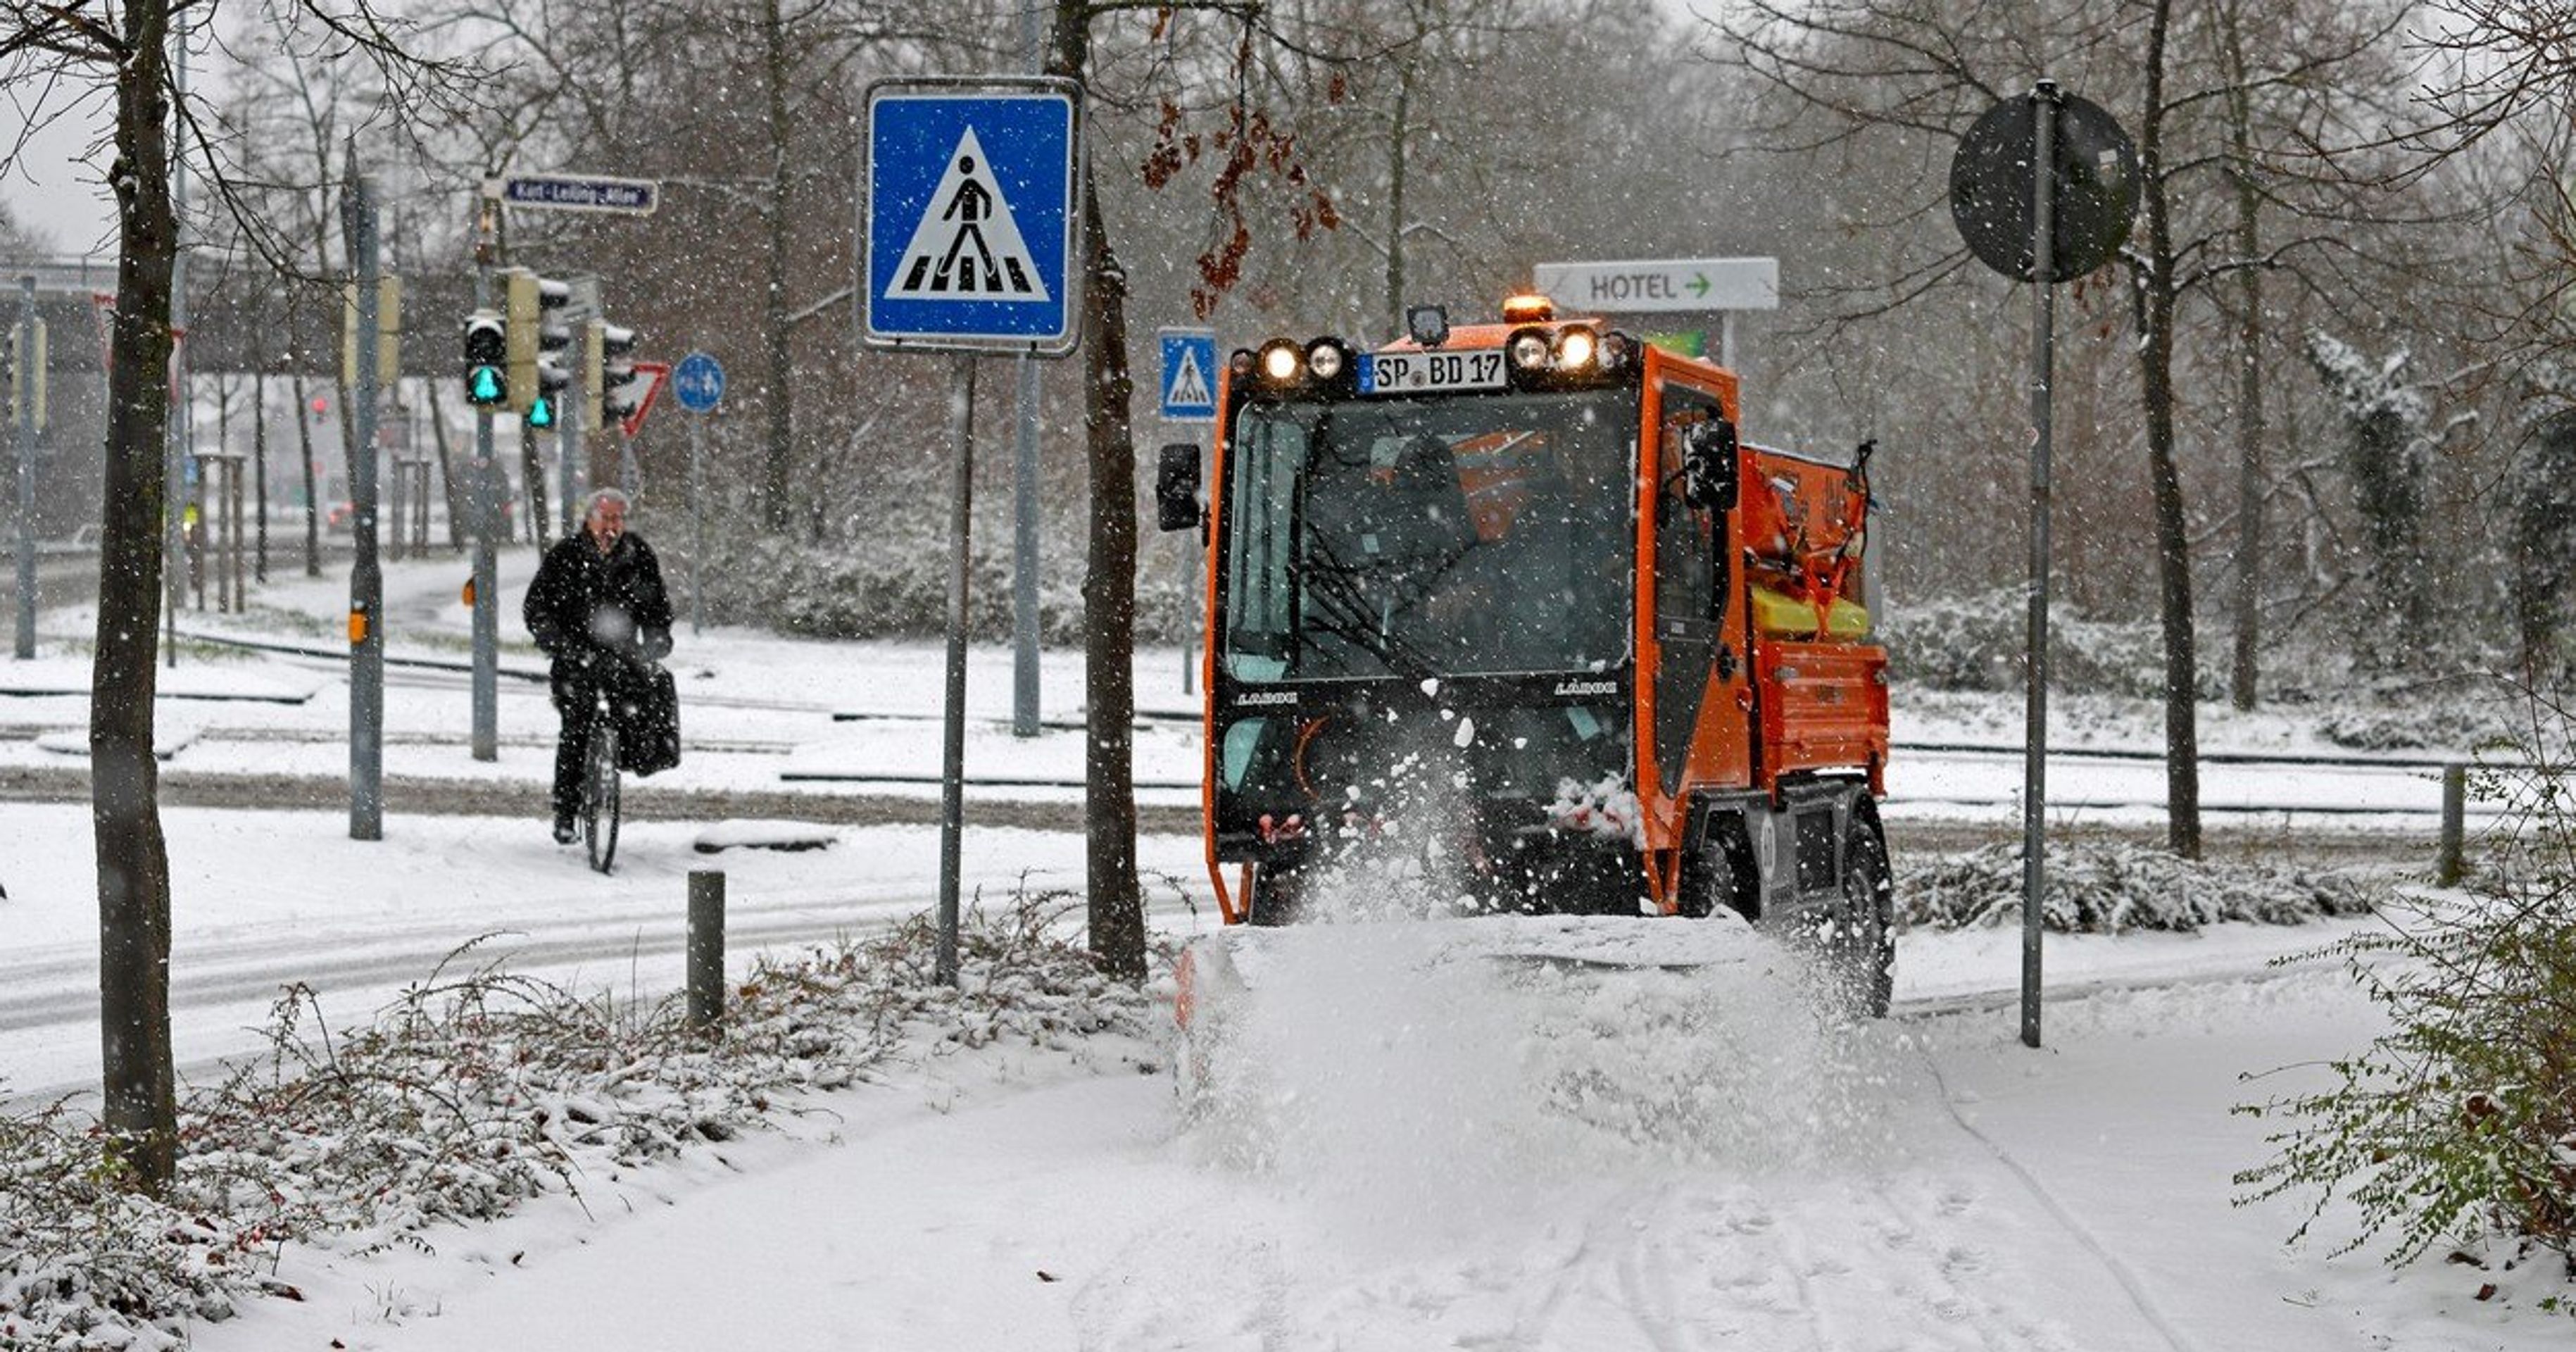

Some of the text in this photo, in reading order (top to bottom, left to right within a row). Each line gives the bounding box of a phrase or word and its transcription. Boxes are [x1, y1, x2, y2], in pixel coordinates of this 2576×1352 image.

[1590, 274, 1678, 299] HOTEL
[1377, 358, 1408, 387] SP
[1430, 356, 1462, 384] BD
[1469, 354, 1500, 382] 17
